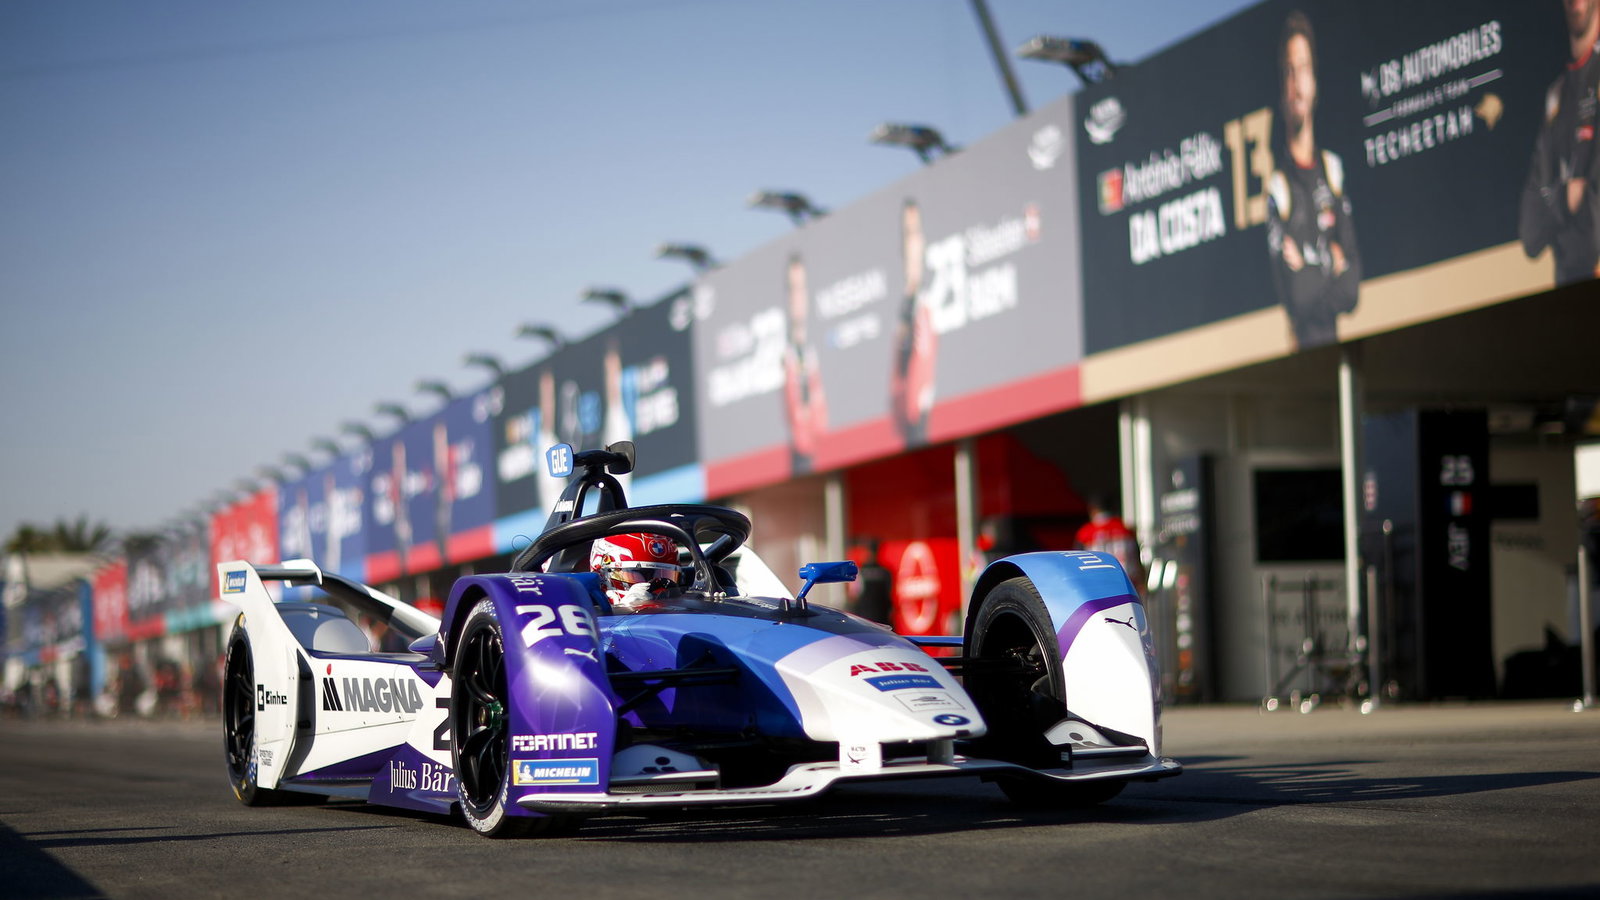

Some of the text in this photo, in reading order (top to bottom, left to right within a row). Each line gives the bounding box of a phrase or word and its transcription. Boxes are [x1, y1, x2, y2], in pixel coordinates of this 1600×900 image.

[1402, 20, 1502, 89] AUTOMOBILES
[1364, 105, 1473, 168] TECHEETAH
[1223, 106, 1274, 230] 13
[1129, 186, 1226, 265] DA COSTA
[551, 448, 568, 474] GUE
[850, 661, 929, 677] ABB
[342, 677, 424, 713] MAGNA
[512, 732, 597, 751] FORTINET
[390, 760, 454, 793] Julius Bär
[534, 767, 591, 778] MICHELIN
